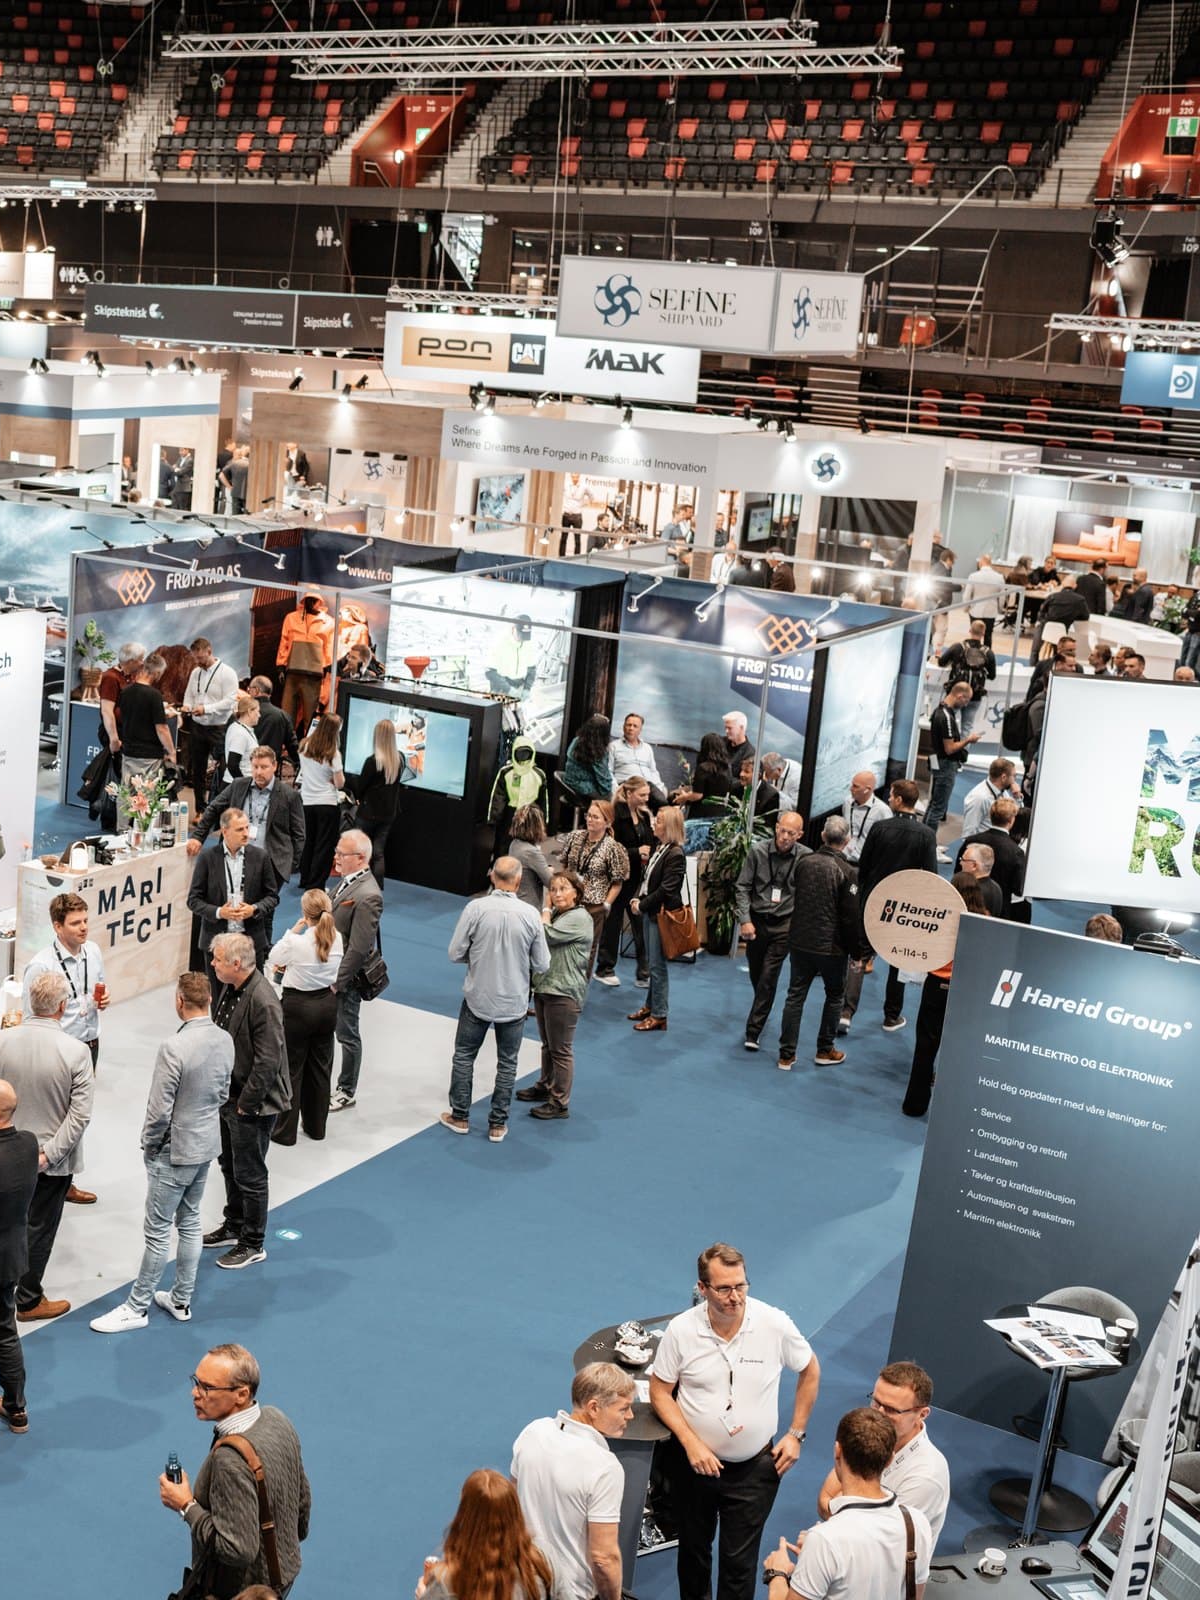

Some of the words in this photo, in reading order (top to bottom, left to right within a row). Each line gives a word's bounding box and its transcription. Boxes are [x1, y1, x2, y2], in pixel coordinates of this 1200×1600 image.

[1181, 243, 1199, 253] 109
[94, 304, 147, 318] Skipsteknisk
[303, 316, 341, 330] Skipsteknisk
[658, 313, 723, 329] SHIPYARD
[418, 337, 492, 356] pon
[511, 341, 544, 364] CAT
[584, 348, 665, 375] MaK
[451, 438, 482, 450] Where
[523, 445, 540, 456] Are
[543, 446, 577, 461] Forged
[579, 450, 588, 461] in
[632, 455, 651, 468] and
[654, 458, 707, 474] Innovation
[97, 866, 163, 916] MARI
[899, 901, 948, 920] Hareid
[106, 903, 173, 948] TECH
[896, 915, 939, 934] Group
[891, 946, 928, 960] A-114-5
[1021, 985, 1103, 1020] Hareid
[1105, 1005, 1183, 1041] Group
[985, 1034, 1031, 1053] MARITIM
[1031, 1046, 1079, 1065] ELEKTRO
[1080, 1057, 1097, 1070] OG
[1098, 1062, 1175, 1089] ELEKTRONIKK
[978, 1075, 999, 1090] Hold
[1000, 1080, 1018, 1095] deg
[1019, 1085, 1063, 1106] oppdatert
[1063, 1098, 1085, 1112] med
[1085, 1103, 1105, 1117] våre
[1106, 1108, 1150, 1129] løsninger
[1152, 1119, 1168, 1133] for:
[980, 1107, 1012, 1123] Service
[977, 1128, 1025, 1150] Ombygging
[1026, 1143, 1038, 1154] og
[1039, 1145, 1068, 1160] retrofit
[974, 1148, 1019, 1168] Landstrøm
[971, 1168, 996, 1183] Tavler
[996, 1177, 1008, 1188] og
[1009, 1179, 1076, 1206] kraftdistribusjon
[966, 1189, 1016, 1211] Automasjon
[1017, 1204, 1029, 1215] og
[1032, 1208, 1075, 1227] svakstrøm
[963, 1209, 995, 1226] Maritim
[996, 1219, 1041, 1239] elektronikk
